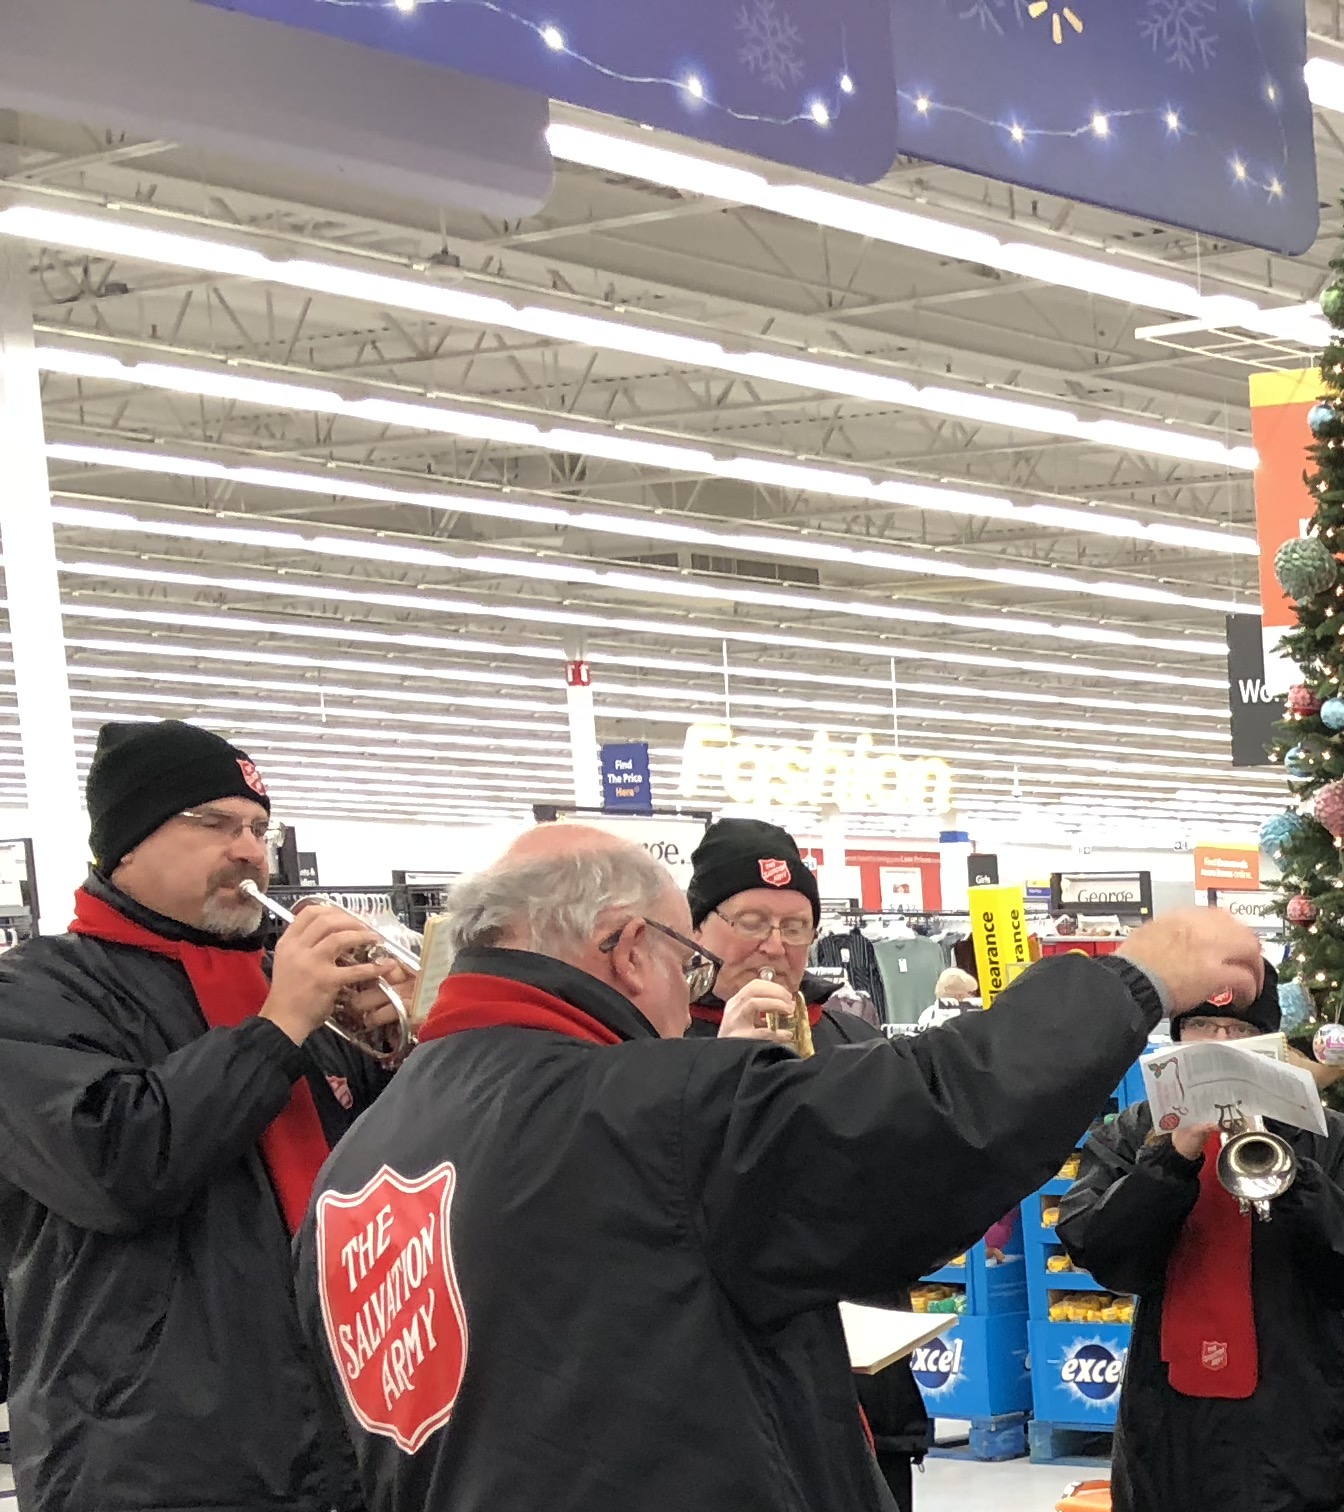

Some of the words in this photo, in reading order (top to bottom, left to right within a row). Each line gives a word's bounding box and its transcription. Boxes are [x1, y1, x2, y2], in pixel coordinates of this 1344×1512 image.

[975, 874, 991, 885] Girls
[1077, 889, 1134, 903] George
[982, 911, 1003, 1001] learance
[341, 1204, 395, 1292] THE
[338, 1212, 435, 1380] SALVATION
[381, 1288, 437, 1411] ARMY
